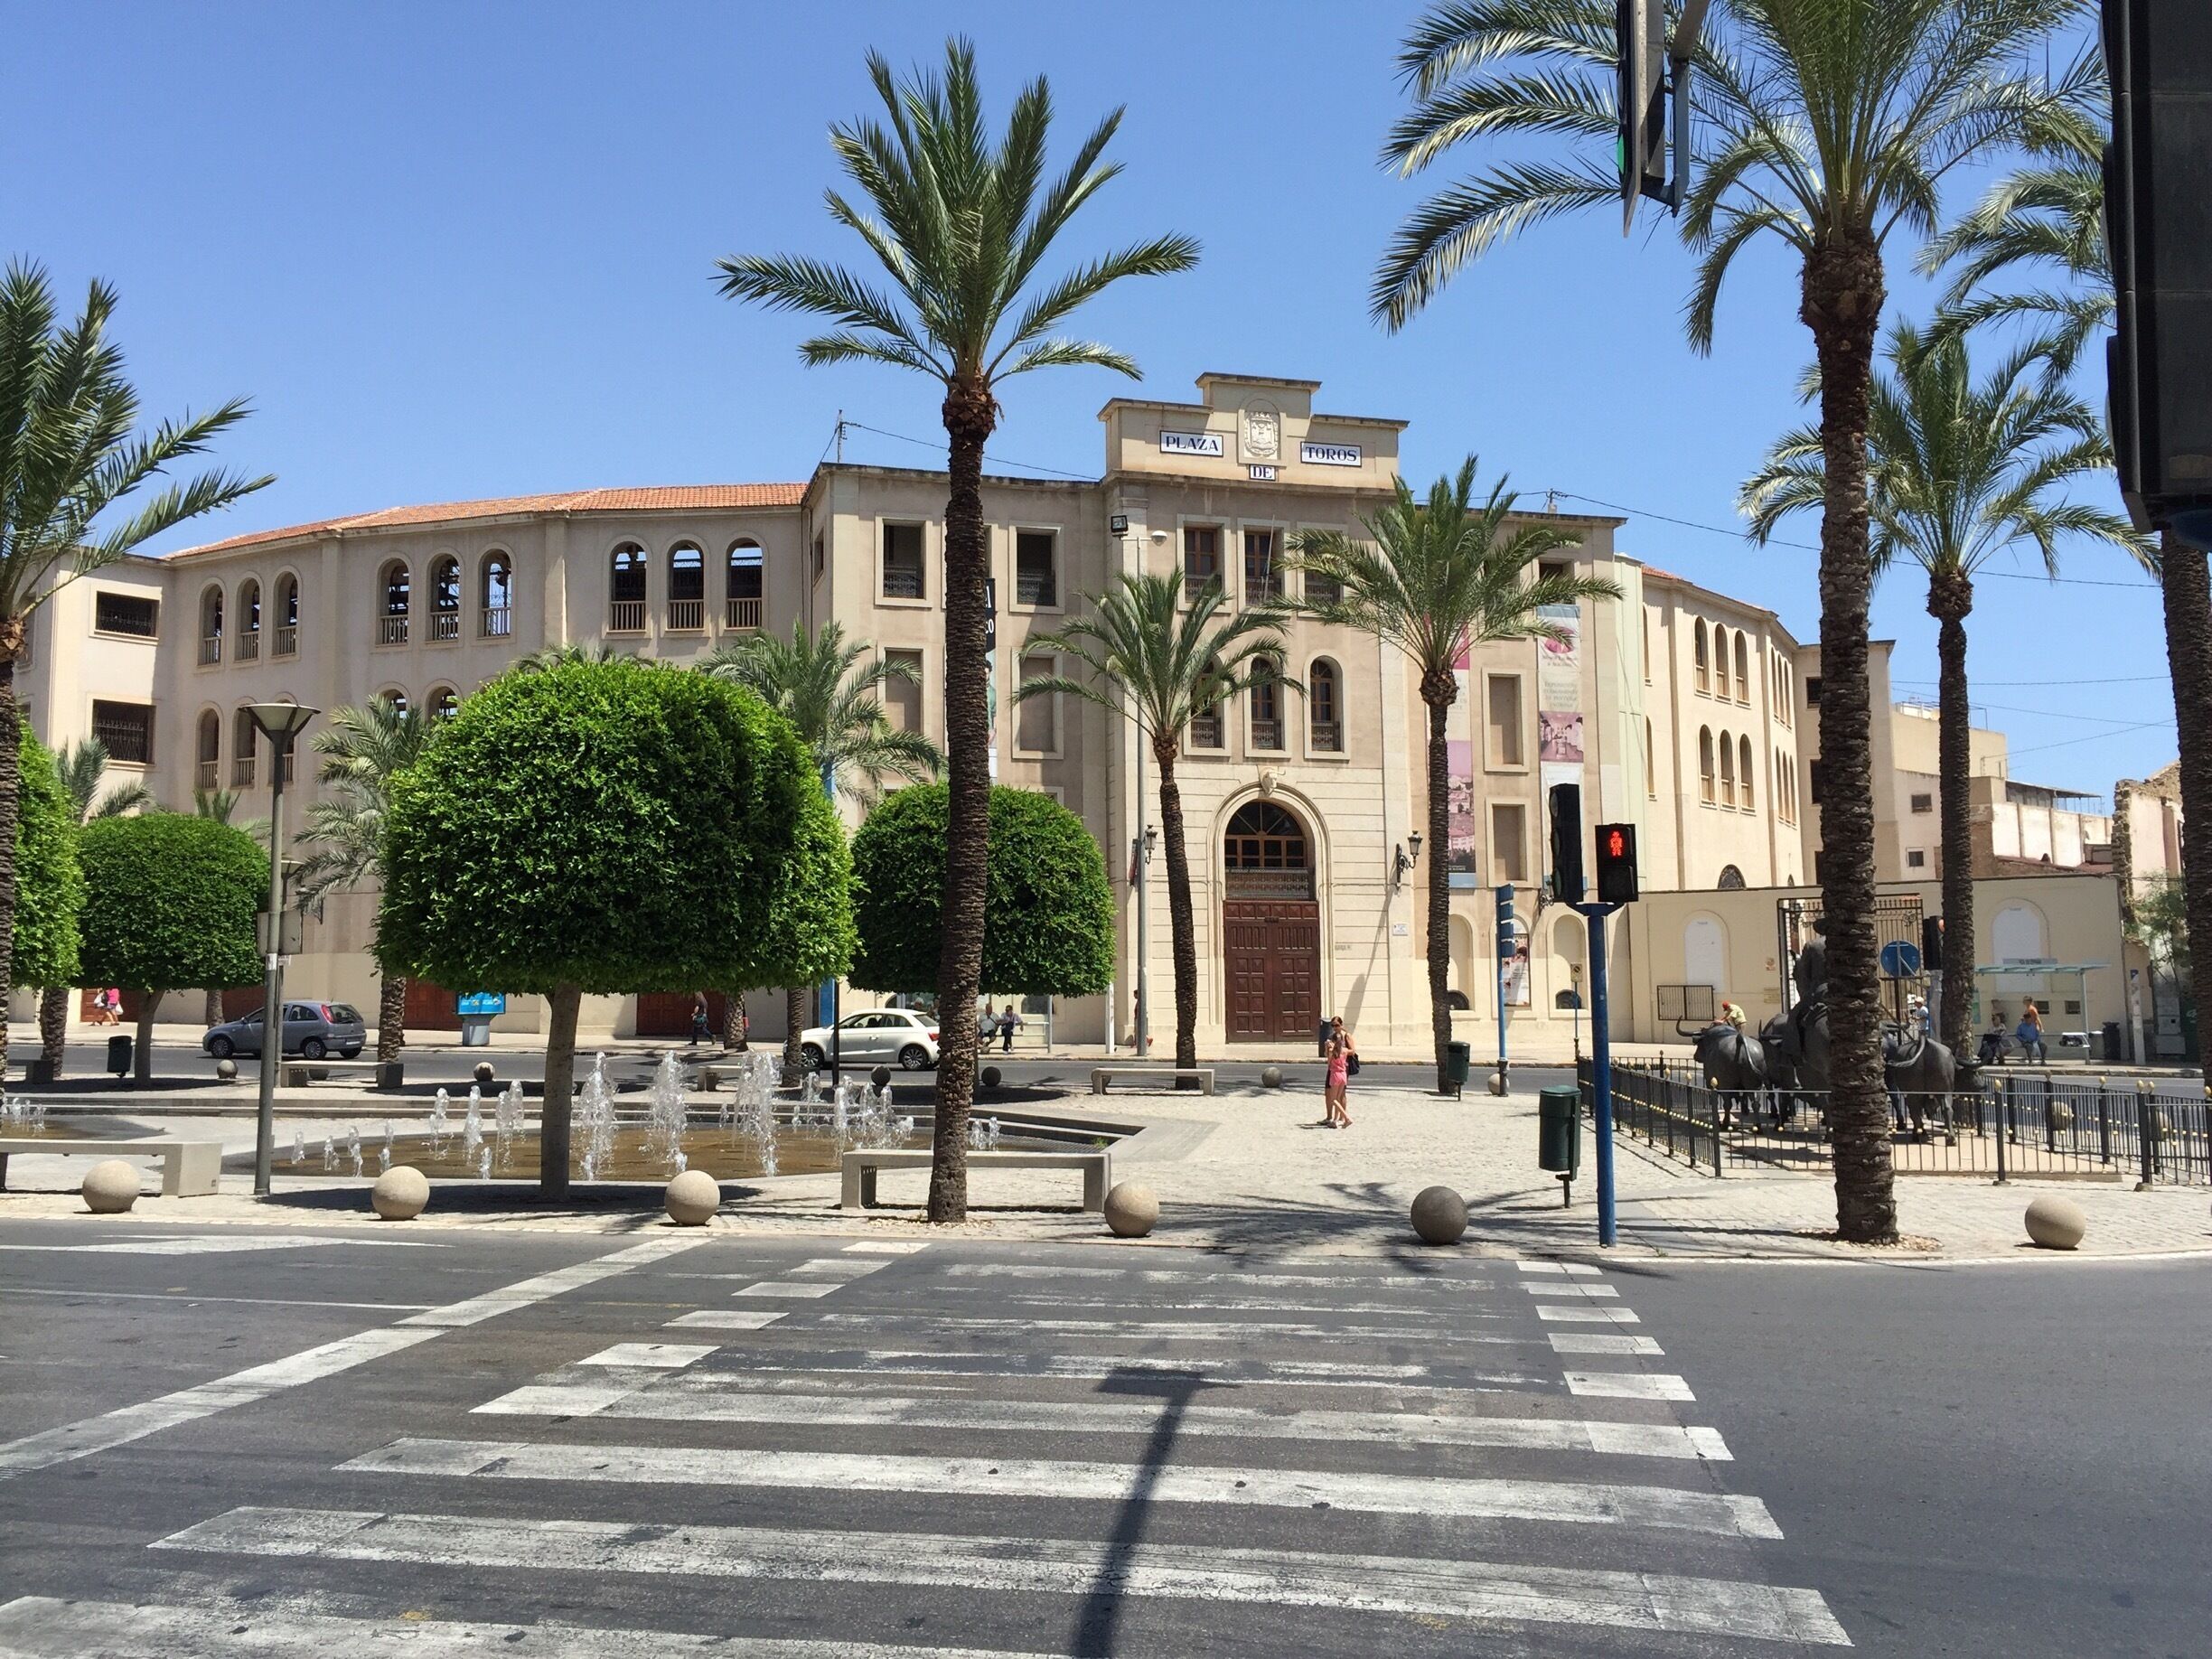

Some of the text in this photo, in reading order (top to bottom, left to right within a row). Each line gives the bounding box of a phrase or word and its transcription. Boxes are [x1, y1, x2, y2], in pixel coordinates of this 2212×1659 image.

[1166, 436, 1219, 452] PLAZA
[1305, 446, 1357, 462] TOROS
[1252, 466, 1273, 479] DE
